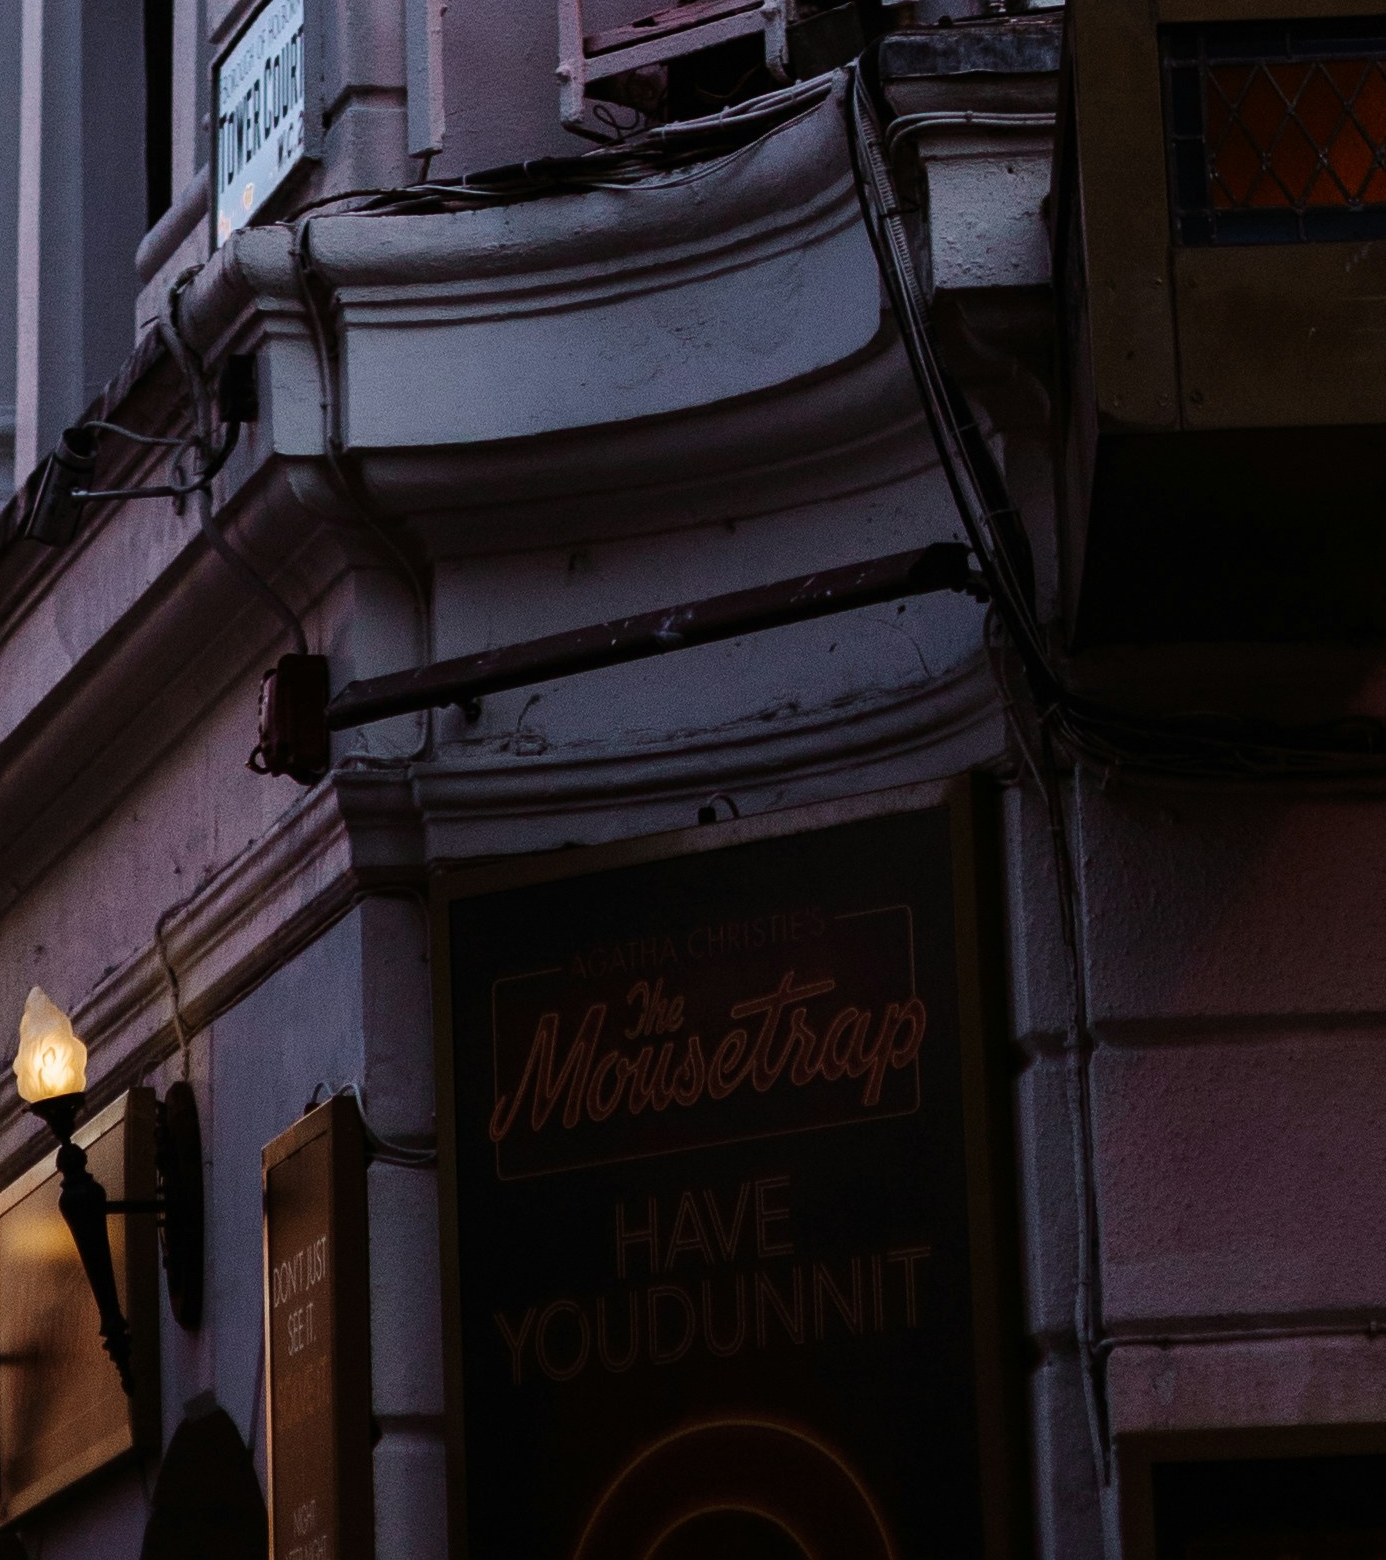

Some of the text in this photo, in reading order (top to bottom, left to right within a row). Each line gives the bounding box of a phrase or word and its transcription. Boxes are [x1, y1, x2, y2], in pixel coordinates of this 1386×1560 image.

[219, 79, 261, 194] TOWER
[569, 905, 827, 979] AGATHA CHRISTIE'S
[625, 976, 685, 1040] The
[488, 970, 928, 1143] Mousetrap
[272, 1235, 327, 1308] DON'T JUST
[615, 1173, 795, 1280] HAVE
[287, 1306, 305, 1356] SEE
[492, 1244, 932, 1386] YOUDUNNIT
